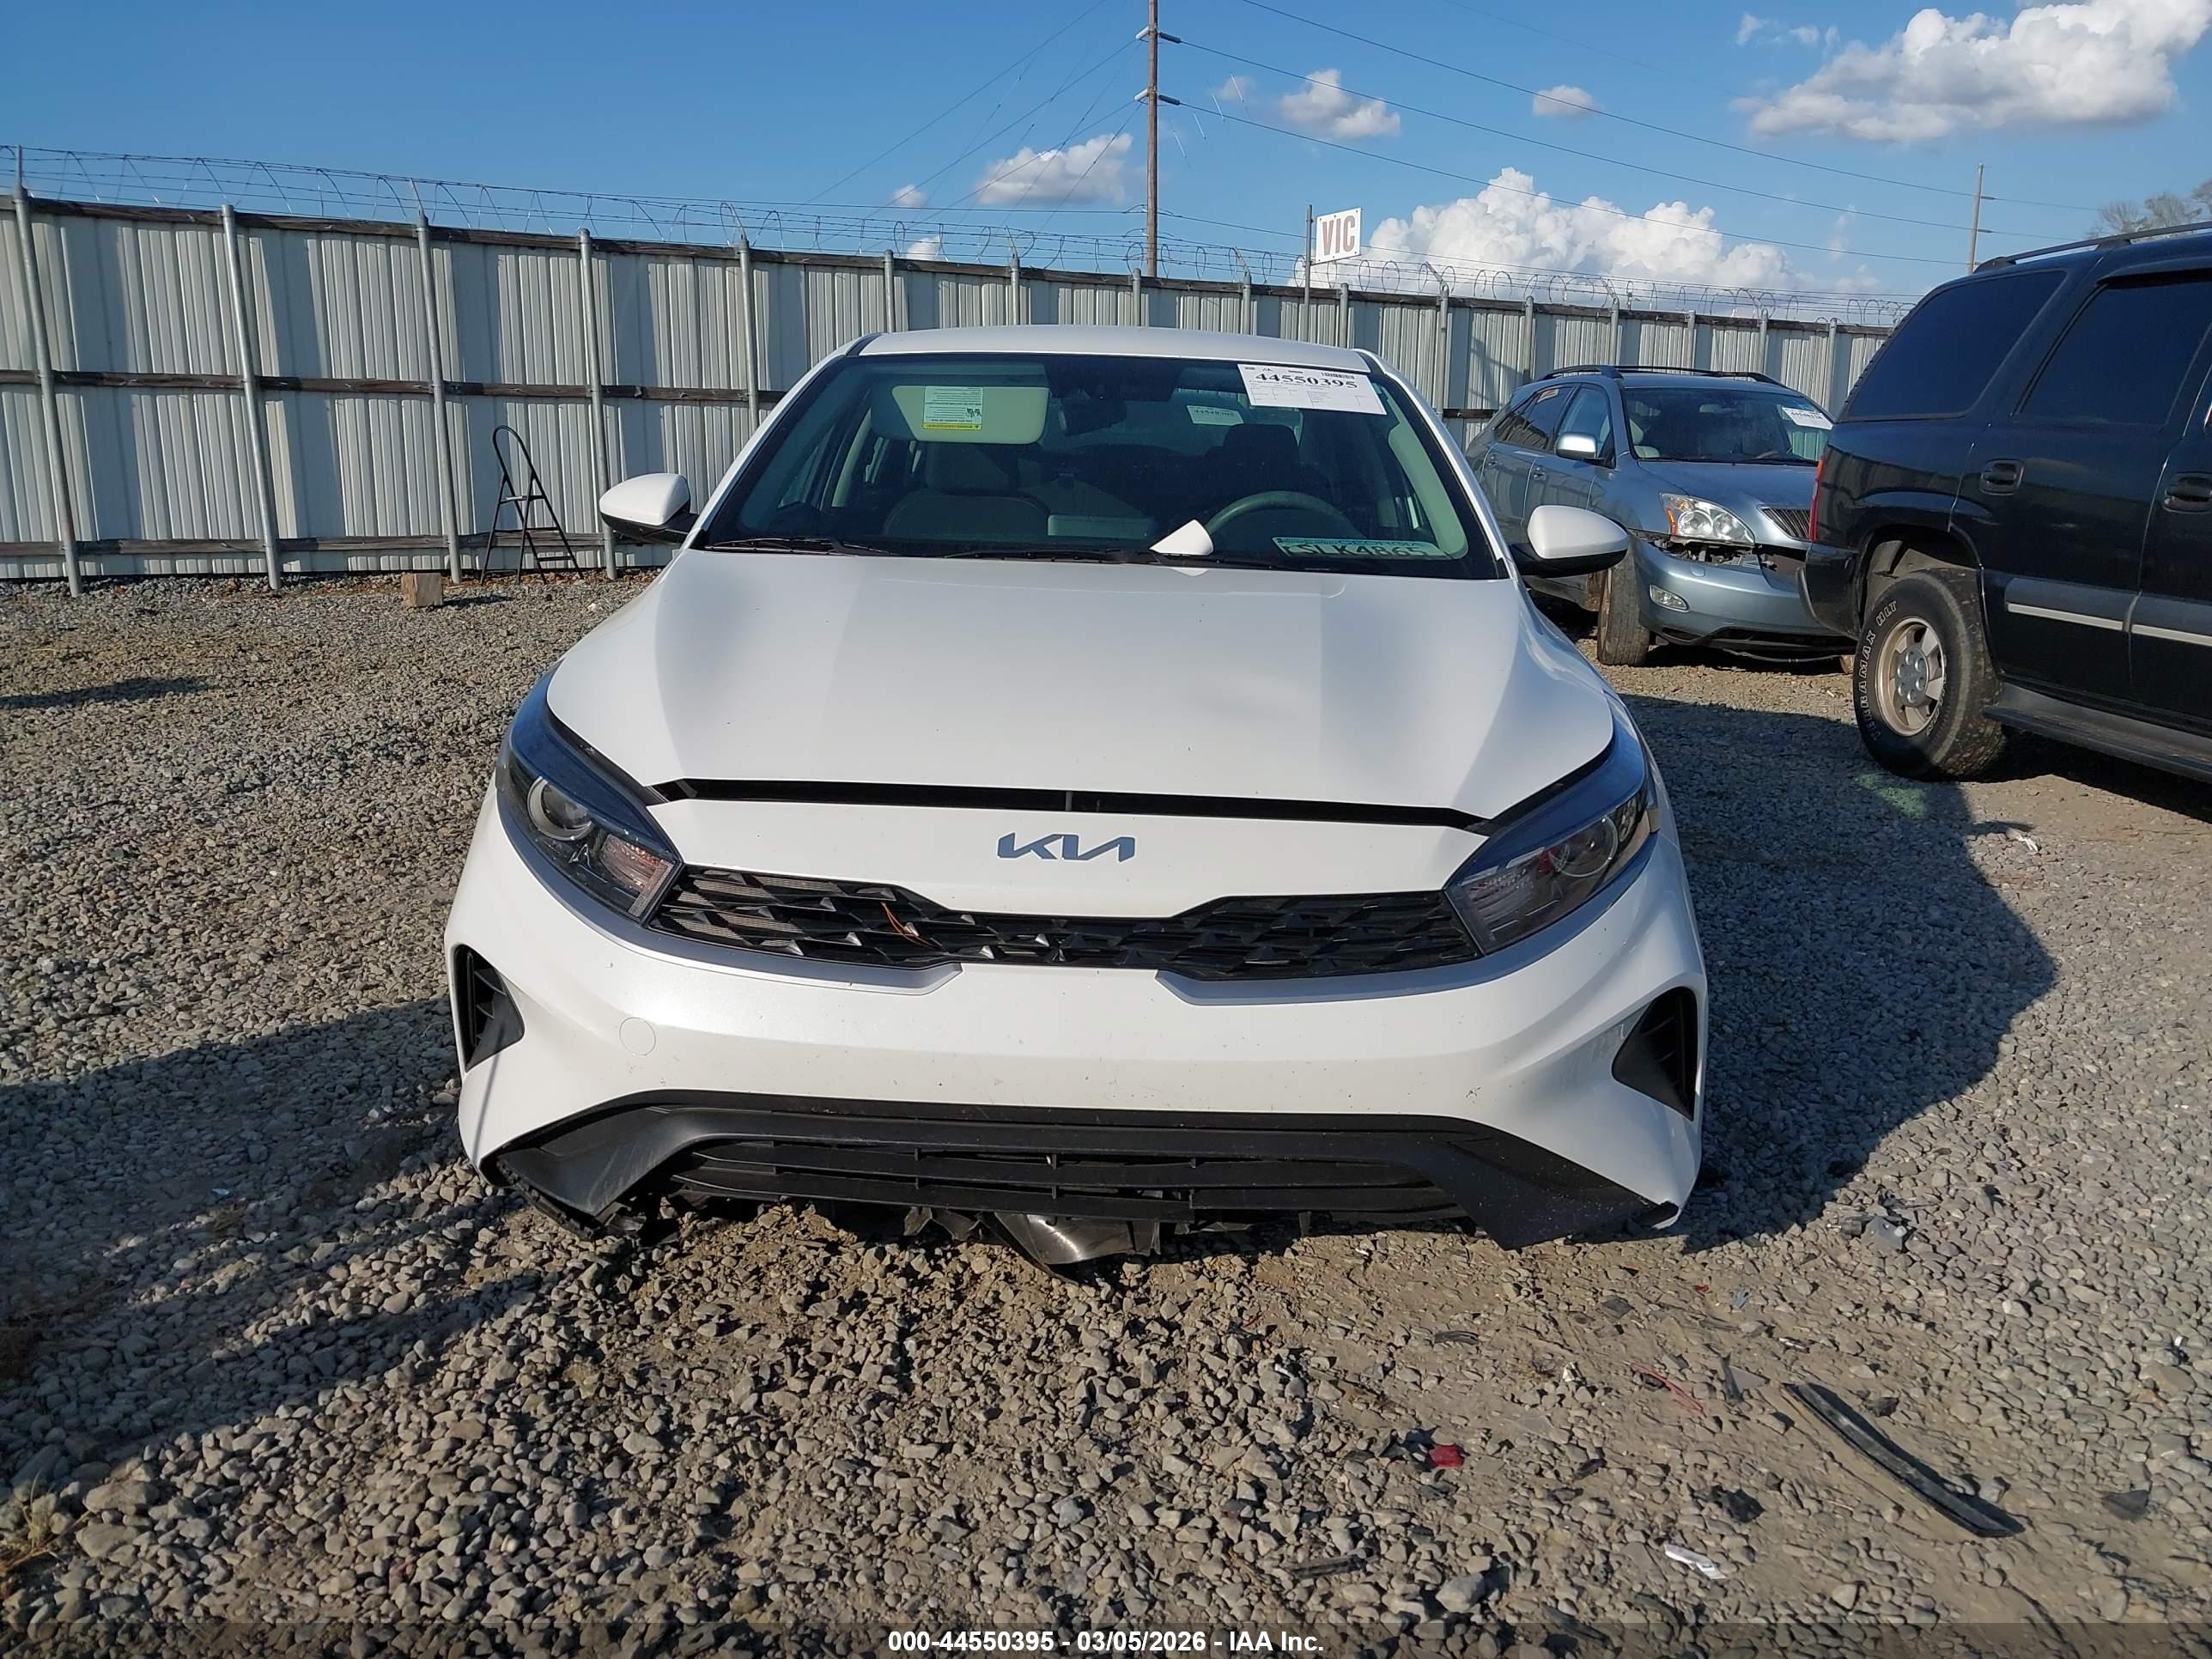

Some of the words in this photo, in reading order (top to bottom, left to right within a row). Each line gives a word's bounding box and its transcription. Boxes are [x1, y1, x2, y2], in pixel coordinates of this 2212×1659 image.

[1322, 216, 1355, 256] VIC
[1255, 373, 1358, 389] 44550395
[1875, 600, 1897, 627] HLT
[998, 832, 1136, 863] KIA
